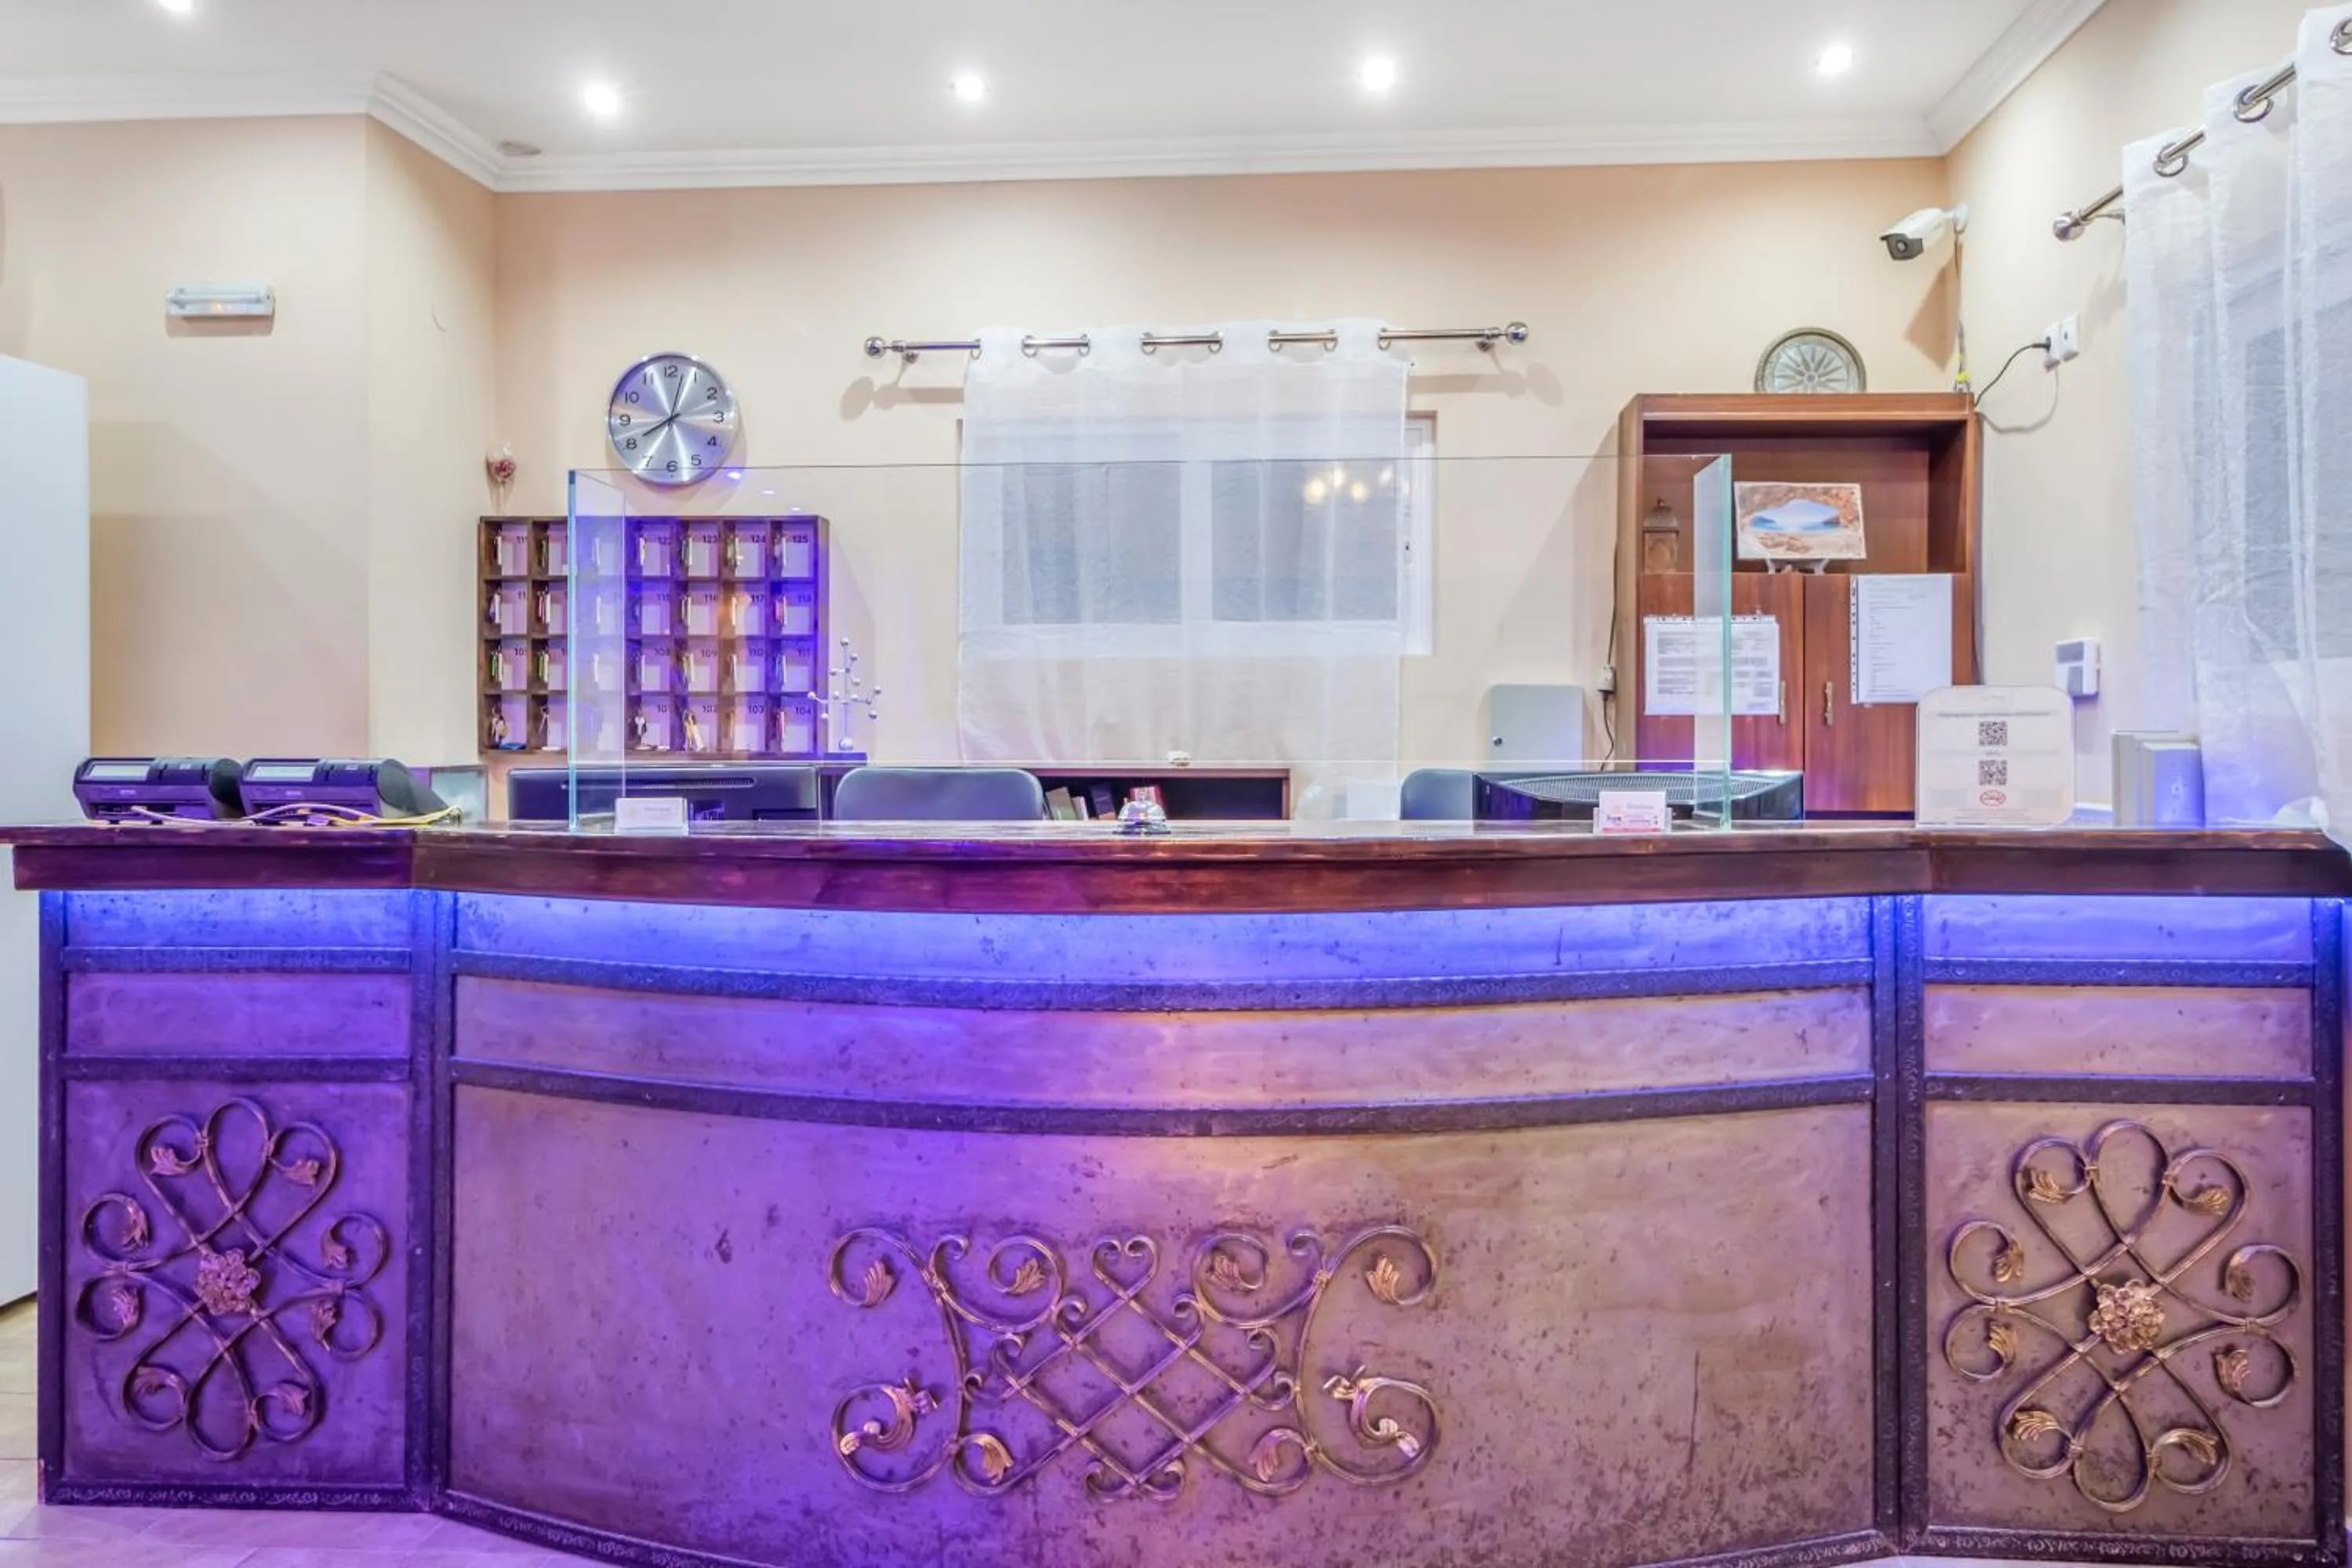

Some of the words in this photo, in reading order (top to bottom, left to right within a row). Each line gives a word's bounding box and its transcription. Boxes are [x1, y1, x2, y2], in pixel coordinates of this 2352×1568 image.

[664, 365, 678, 378] 12
[694, 371, 697, 383] 1
[643, 372, 654, 385] 11
[624, 391, 640, 404] 10
[706, 387, 717, 401] 2
[619, 414, 631, 426] 9
[713, 410, 724, 423] 3
[626, 438, 637, 449] 8
[706, 435, 717, 447] 4
[642, 454, 653, 467] 7
[666, 460, 678, 472] 6
[691, 454, 702, 466] 5
[792, 535, 808, 543] 125
[747, 705, 765, 713] 103
